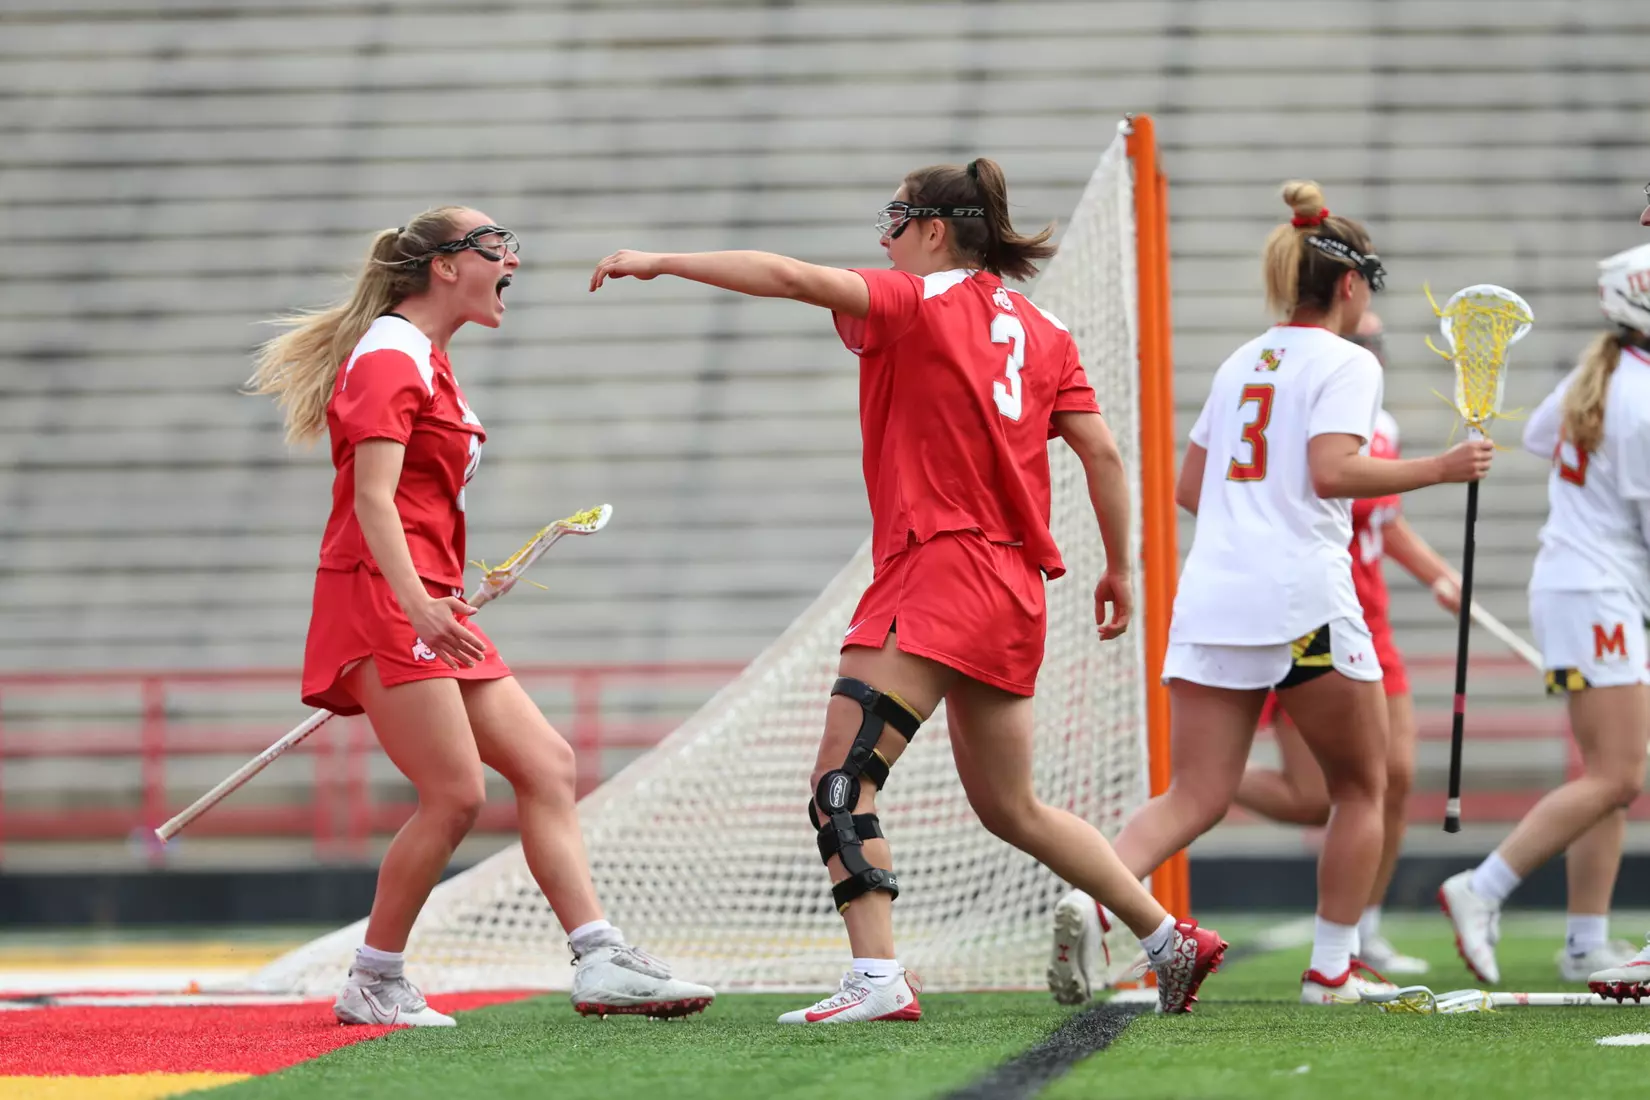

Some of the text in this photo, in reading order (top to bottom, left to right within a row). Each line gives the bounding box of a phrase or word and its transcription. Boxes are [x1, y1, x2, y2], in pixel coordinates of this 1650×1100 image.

[908, 207, 984, 216] STX STX
[990, 312, 1026, 421] 3
[1226, 383, 1275, 482] 3
[1592, 622, 1629, 662] M
